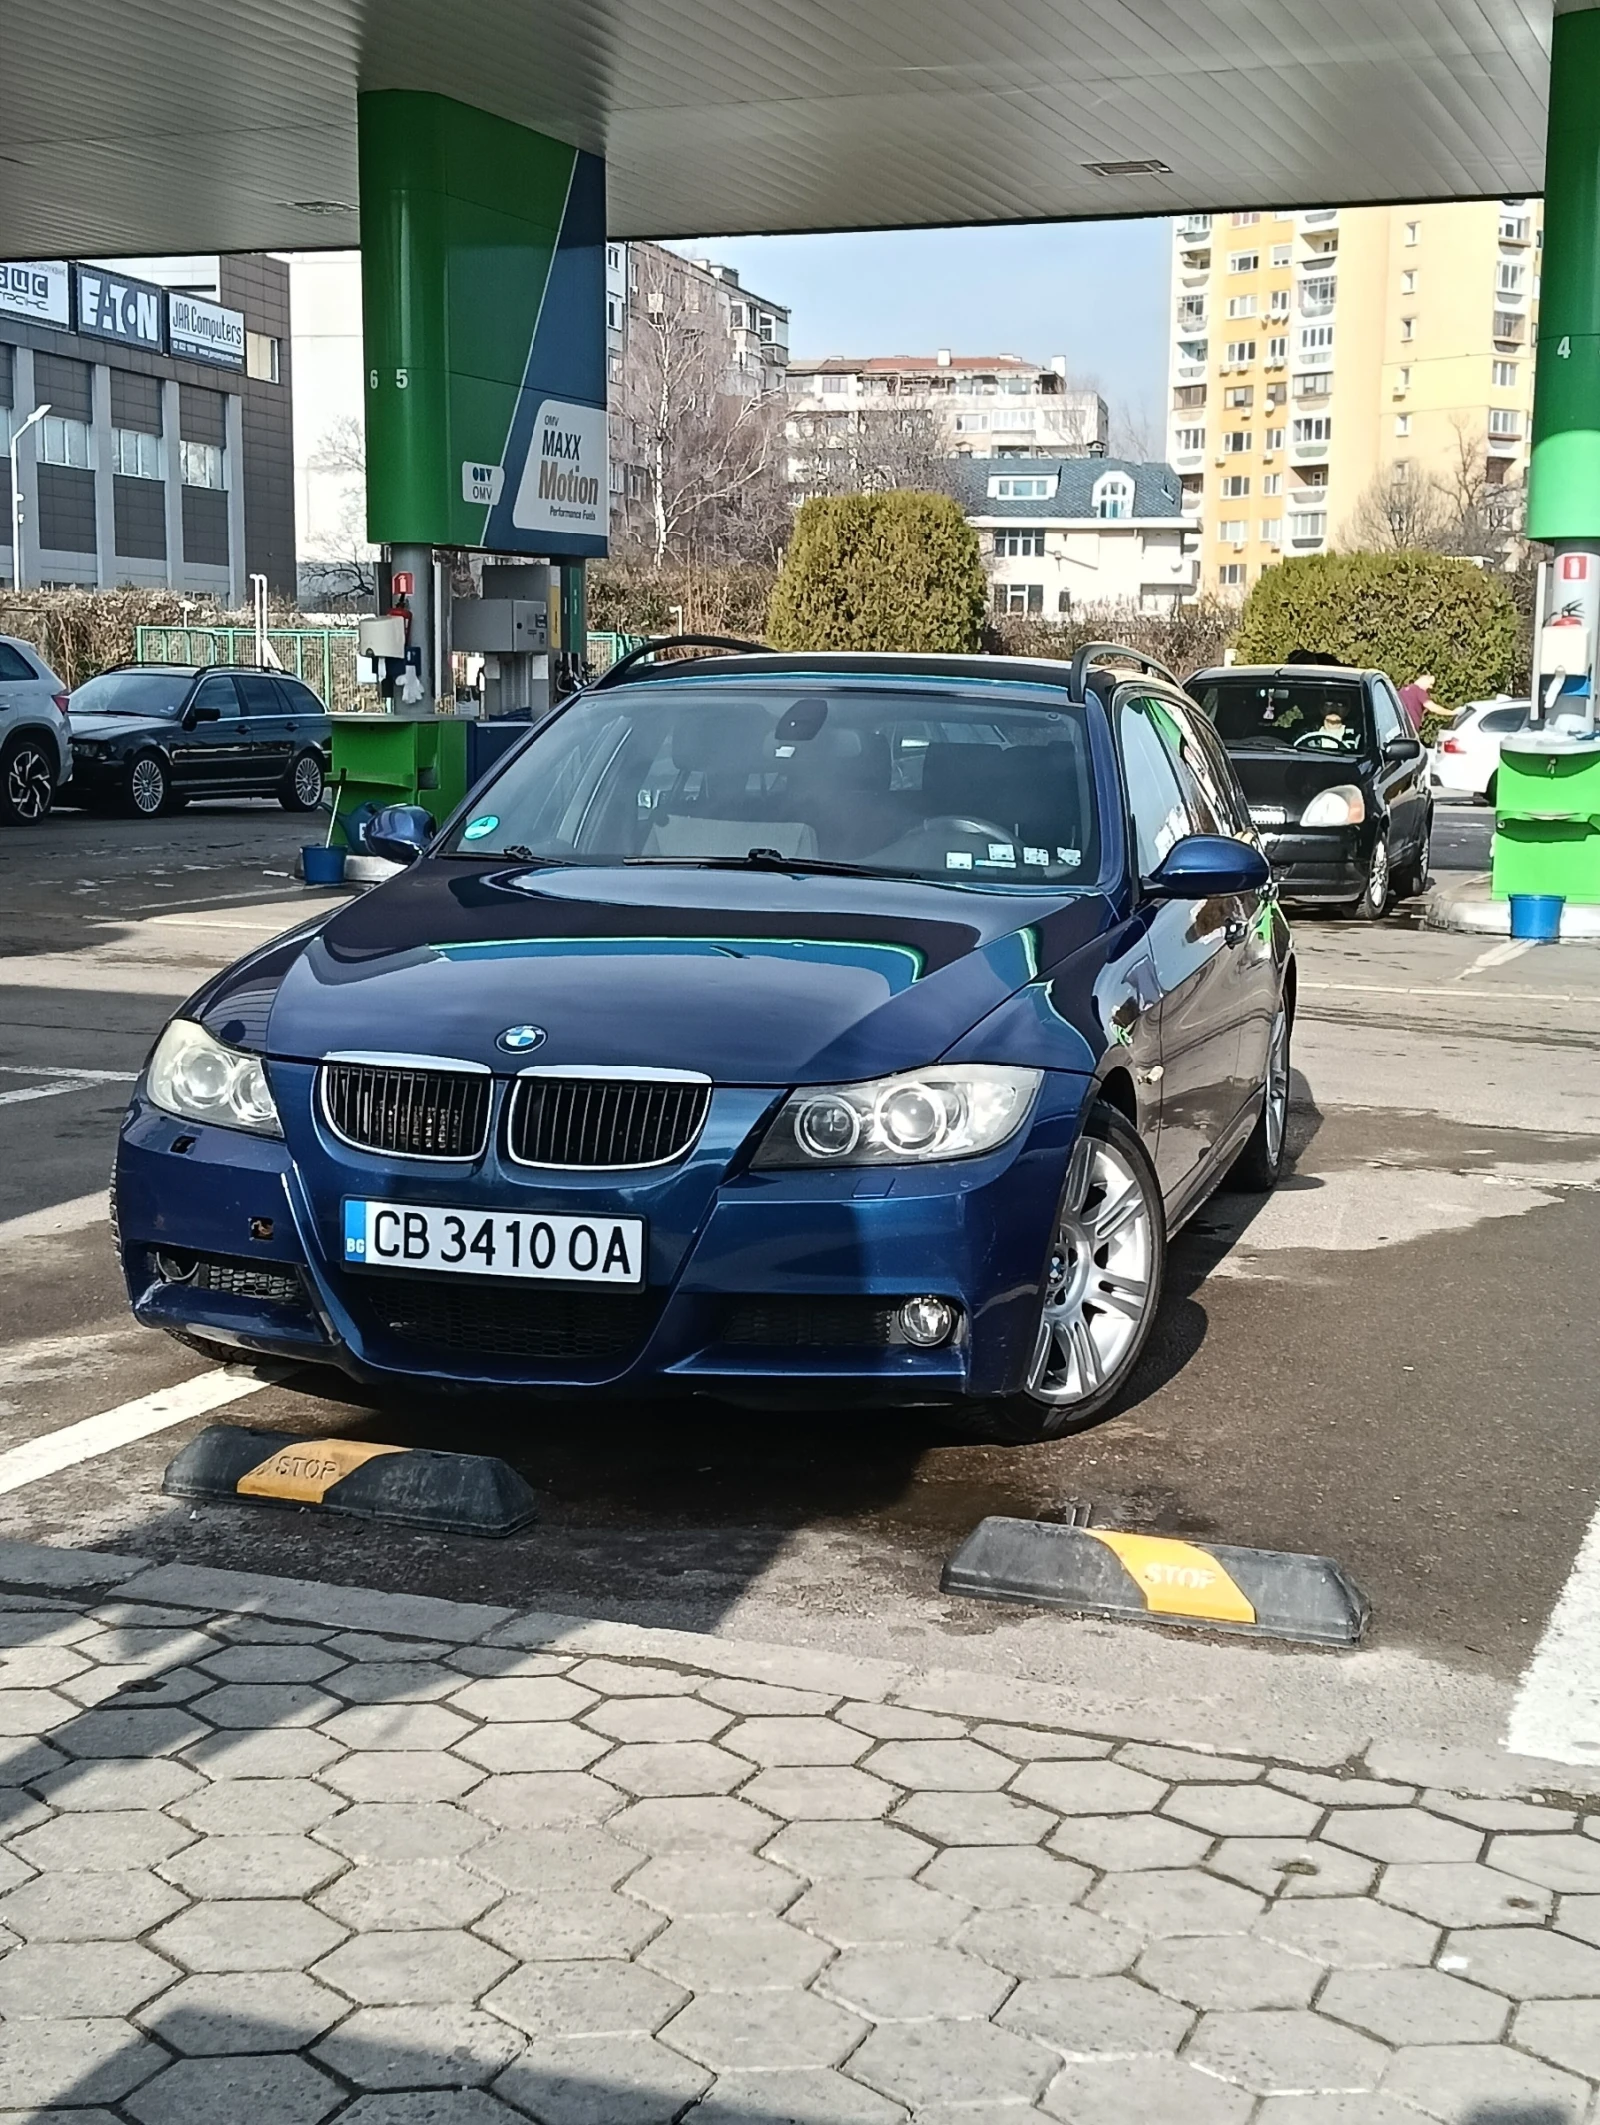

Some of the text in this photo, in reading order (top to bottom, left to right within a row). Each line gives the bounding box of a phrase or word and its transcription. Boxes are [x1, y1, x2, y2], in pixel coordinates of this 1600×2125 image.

[81, 275, 158, 342] EATON
[172, 301, 242, 345] JAR Computers
[1557, 336, 1571, 359] 4
[369, 368, 408, 389] 6 5
[544, 414, 559, 427] OMV
[542, 429, 582, 461] MAXX
[472, 485, 492, 501] OMV
[538, 460, 599, 505] Motion
[346, 1238, 365, 1253] BG
[374, 1210, 631, 1275] CB 3410 OA
[275, 1455, 337, 1480] STOP
[1145, 1562, 1217, 1589] STOP
